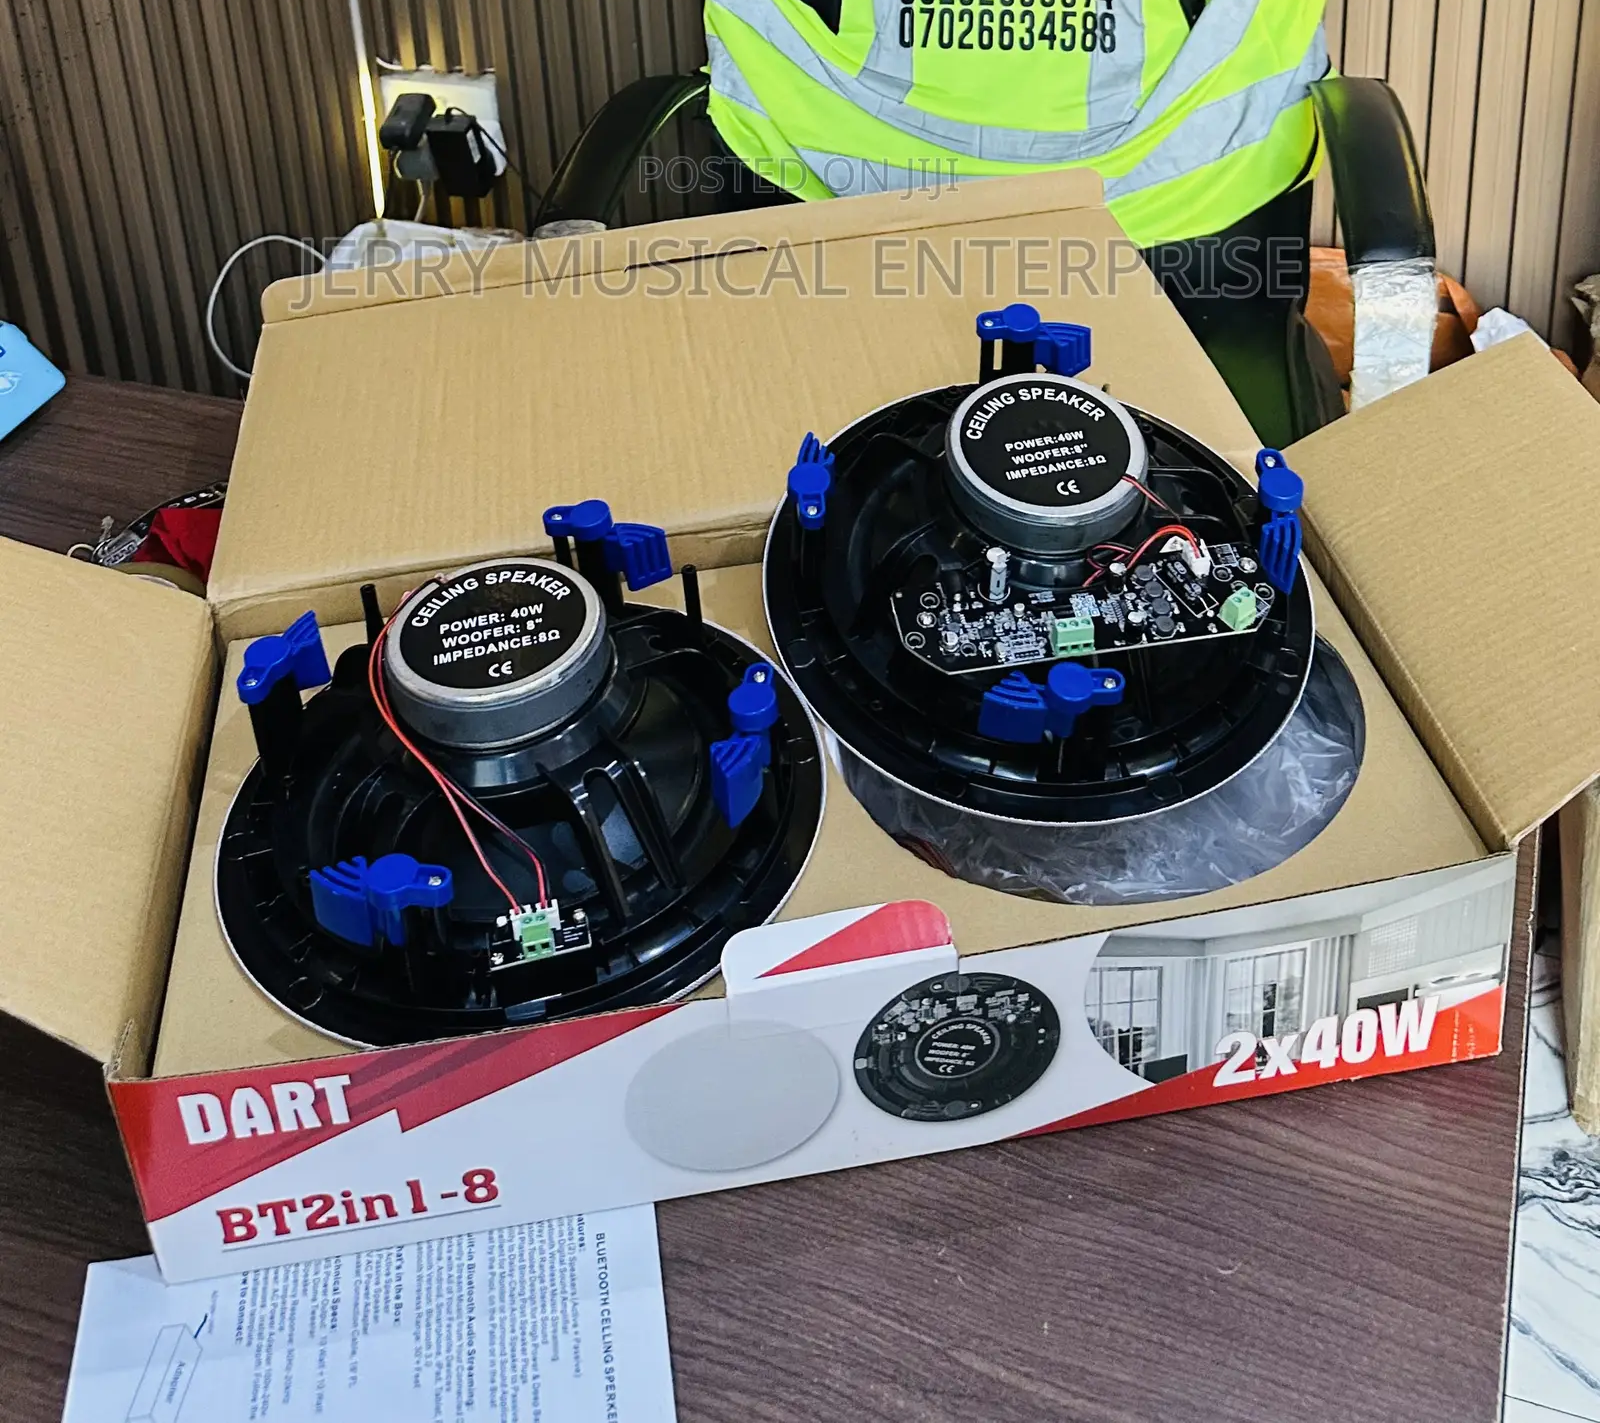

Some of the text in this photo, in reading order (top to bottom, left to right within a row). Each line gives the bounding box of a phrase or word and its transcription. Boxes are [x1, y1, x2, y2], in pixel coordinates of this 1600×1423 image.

[900, 7, 1116, 53] 07026634588
[966, 387, 1106, 440] CEILING SPEAKER
[411, 570, 571, 628] CEILING SPEAKER
[439, 603, 544, 635] POWER: 40W
[442, 623, 521, 649] WOOFER:
[1212, 995, 1441, 1089] 2x40W
[177, 1074, 351, 1146] DART
[466, 1233, 476, 1261] uilt-in
[577, 1214, 586, 1252] atures:
[331, 1255, 343, 1295] chnical
[395, 1245, 404, 1270] hat's
[596, 1233, 610, 1306] BLUETOOTH
[240, 1287, 249, 1298] to
[394, 1284, 404, 1300] the
[466, 1263, 477, 1313] Bluetooth
[466, 1315, 477, 1348] Audio
[600, 1308, 614, 1364] CELLING
